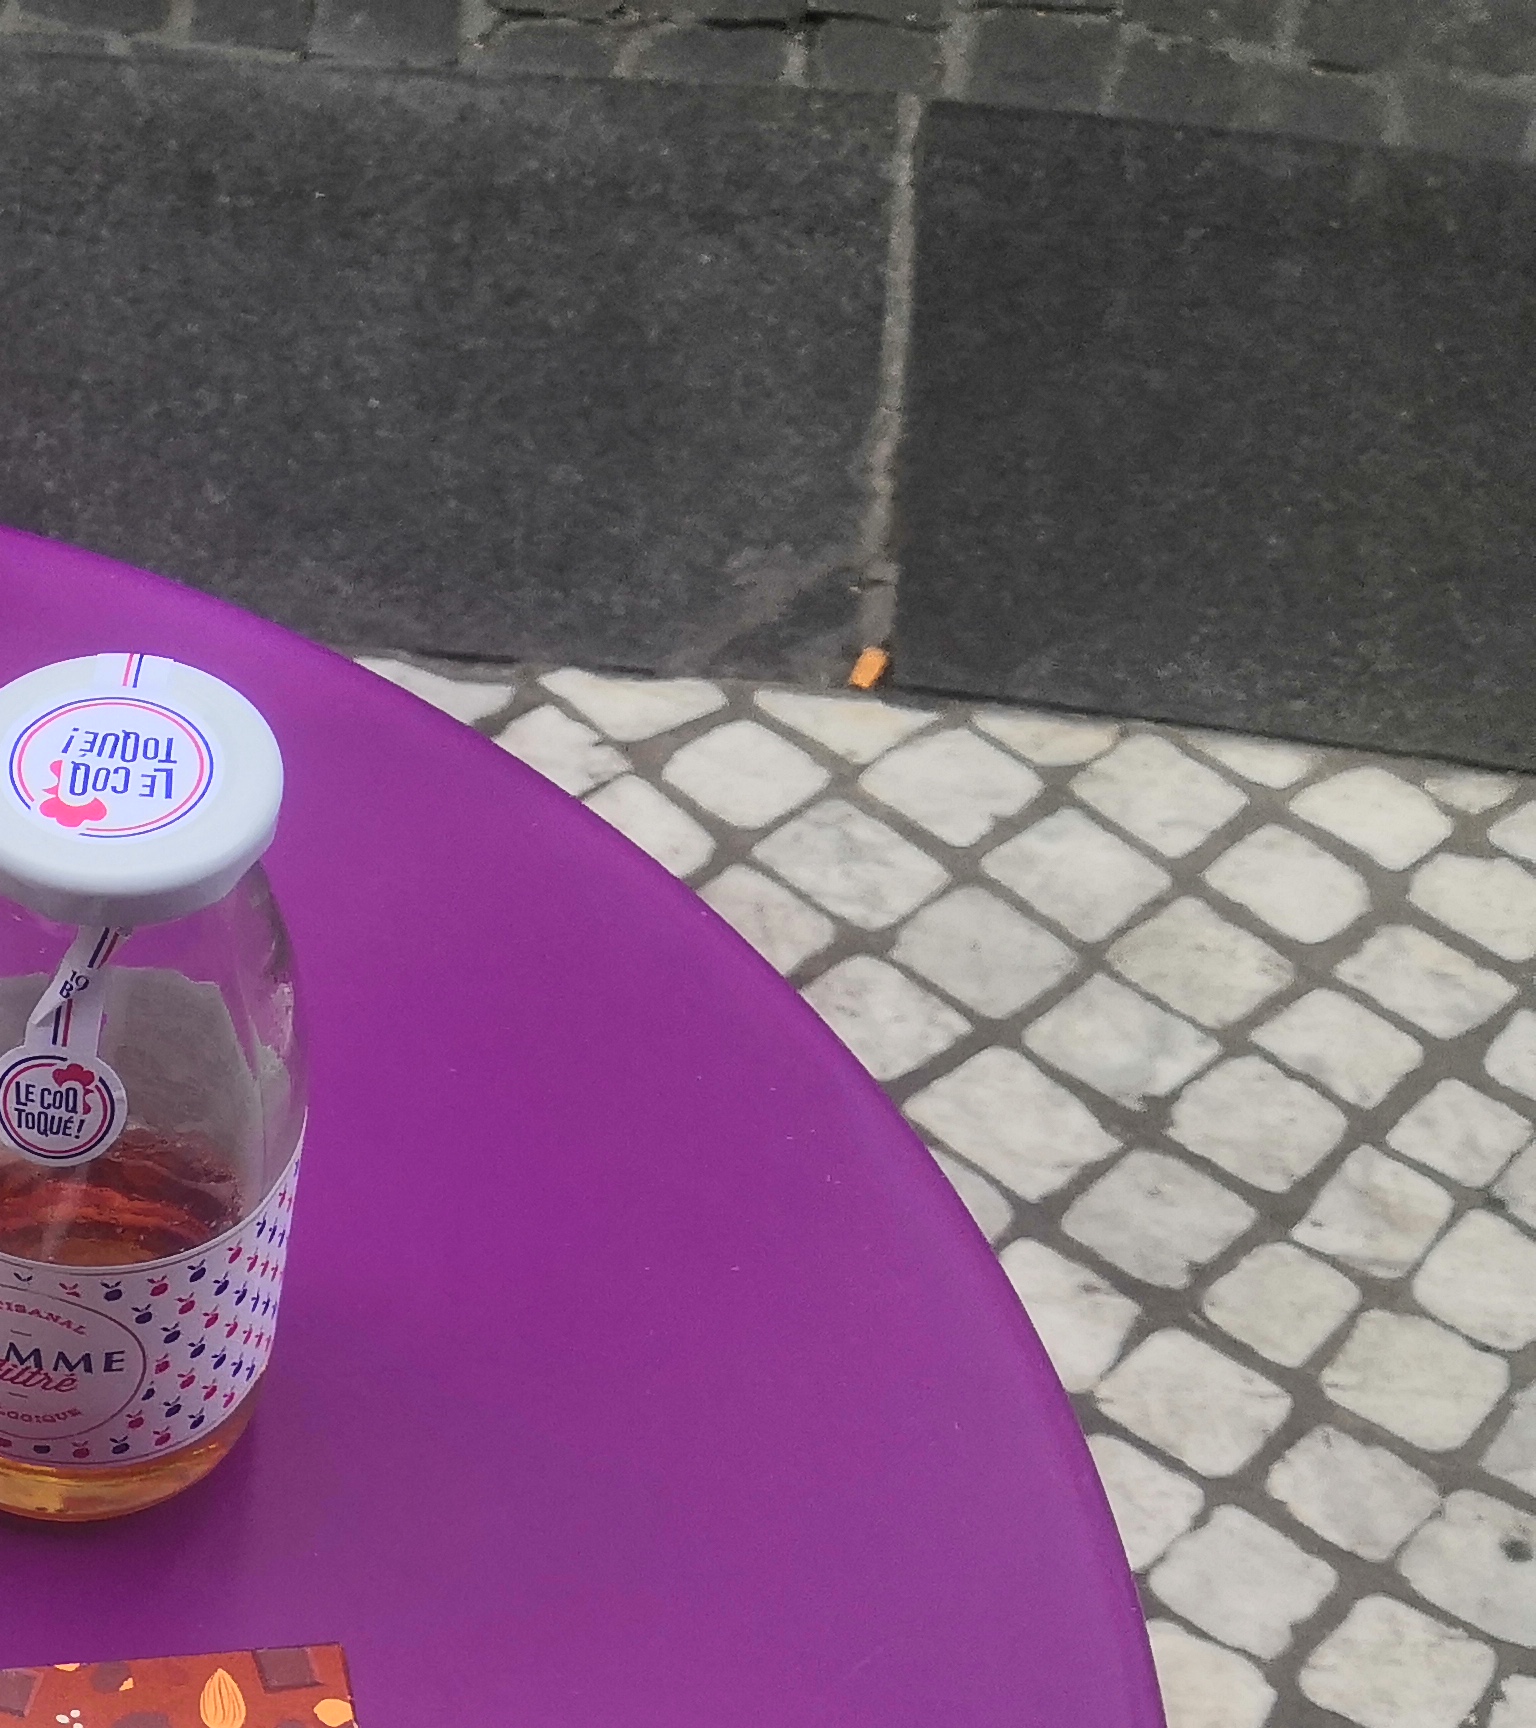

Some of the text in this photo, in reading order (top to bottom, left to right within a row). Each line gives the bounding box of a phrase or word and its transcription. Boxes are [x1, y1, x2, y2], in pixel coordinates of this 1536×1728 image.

[69, 761, 173, 799] LE COQ
[15, 1081, 78, 1115] LE COQ
